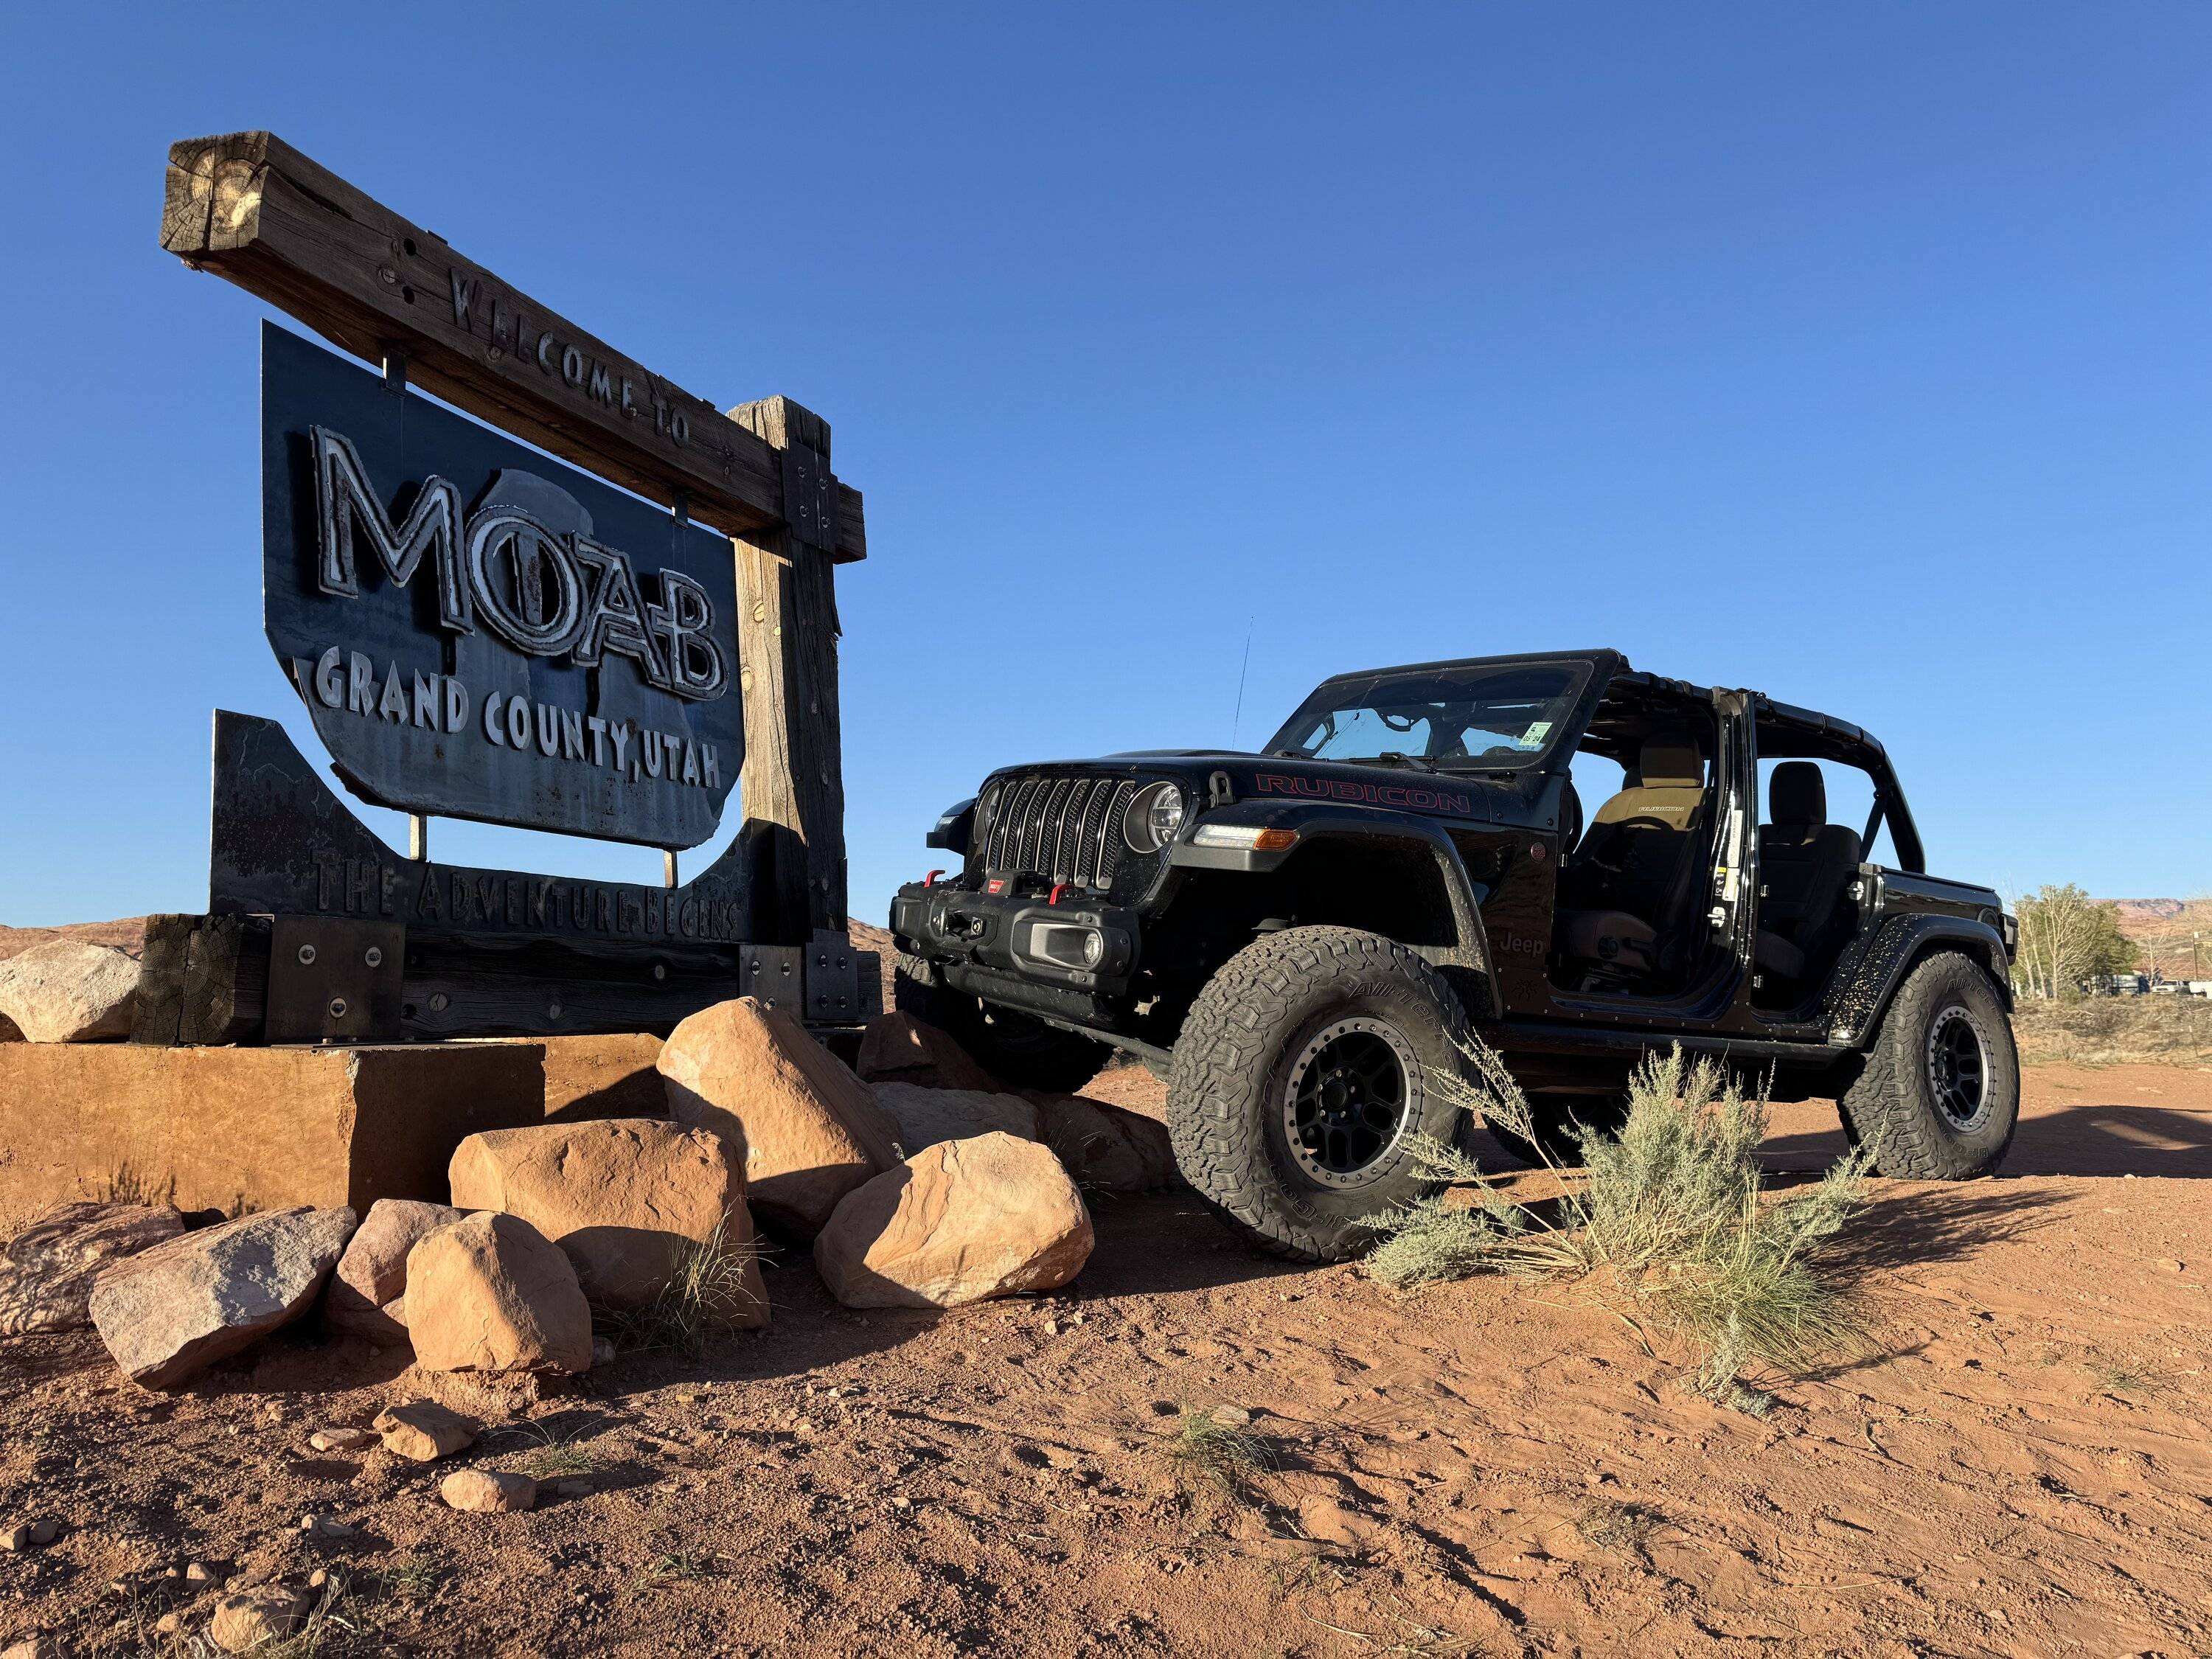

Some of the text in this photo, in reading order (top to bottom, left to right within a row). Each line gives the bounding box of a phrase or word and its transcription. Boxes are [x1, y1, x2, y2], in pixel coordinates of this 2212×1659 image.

[450, 266, 690, 448] WELCOME TO
[308, 424, 730, 701] MOAB
[316, 645, 470, 734] GRAND
[644, 731, 721, 790] UTAH
[1254, 773, 1471, 813] RUBICON
[310, 847, 740, 942] THE ADVENTURE BEGINS
[1498, 931, 1544, 958] Jeep
